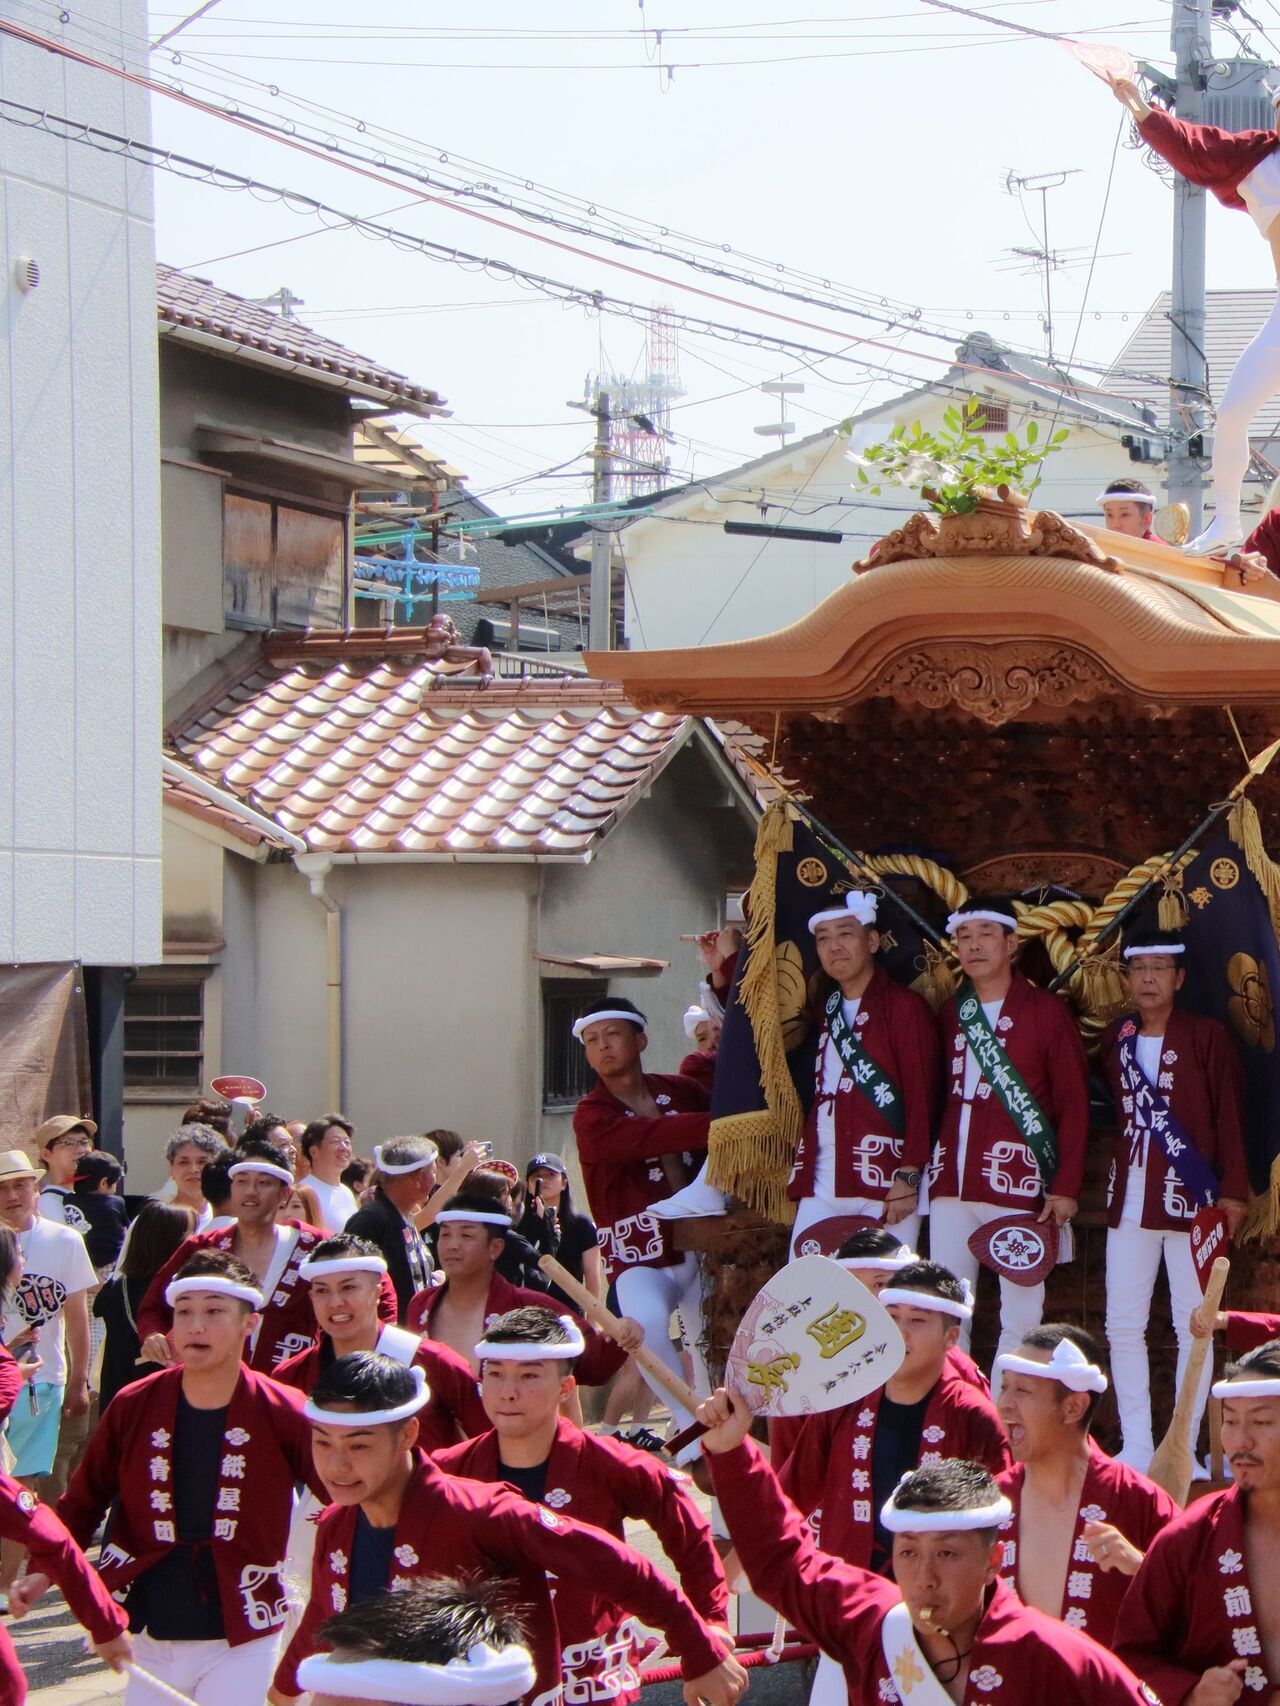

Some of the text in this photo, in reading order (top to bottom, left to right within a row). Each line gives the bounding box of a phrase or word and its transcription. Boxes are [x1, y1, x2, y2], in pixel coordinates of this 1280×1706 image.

[831, 1011, 895, 1108] 副責任者
[150, 1456, 176, 1543] 青年団
[214, 1453, 247, 1542] 紙屋町
[852, 1434, 872, 1523] 青年団
